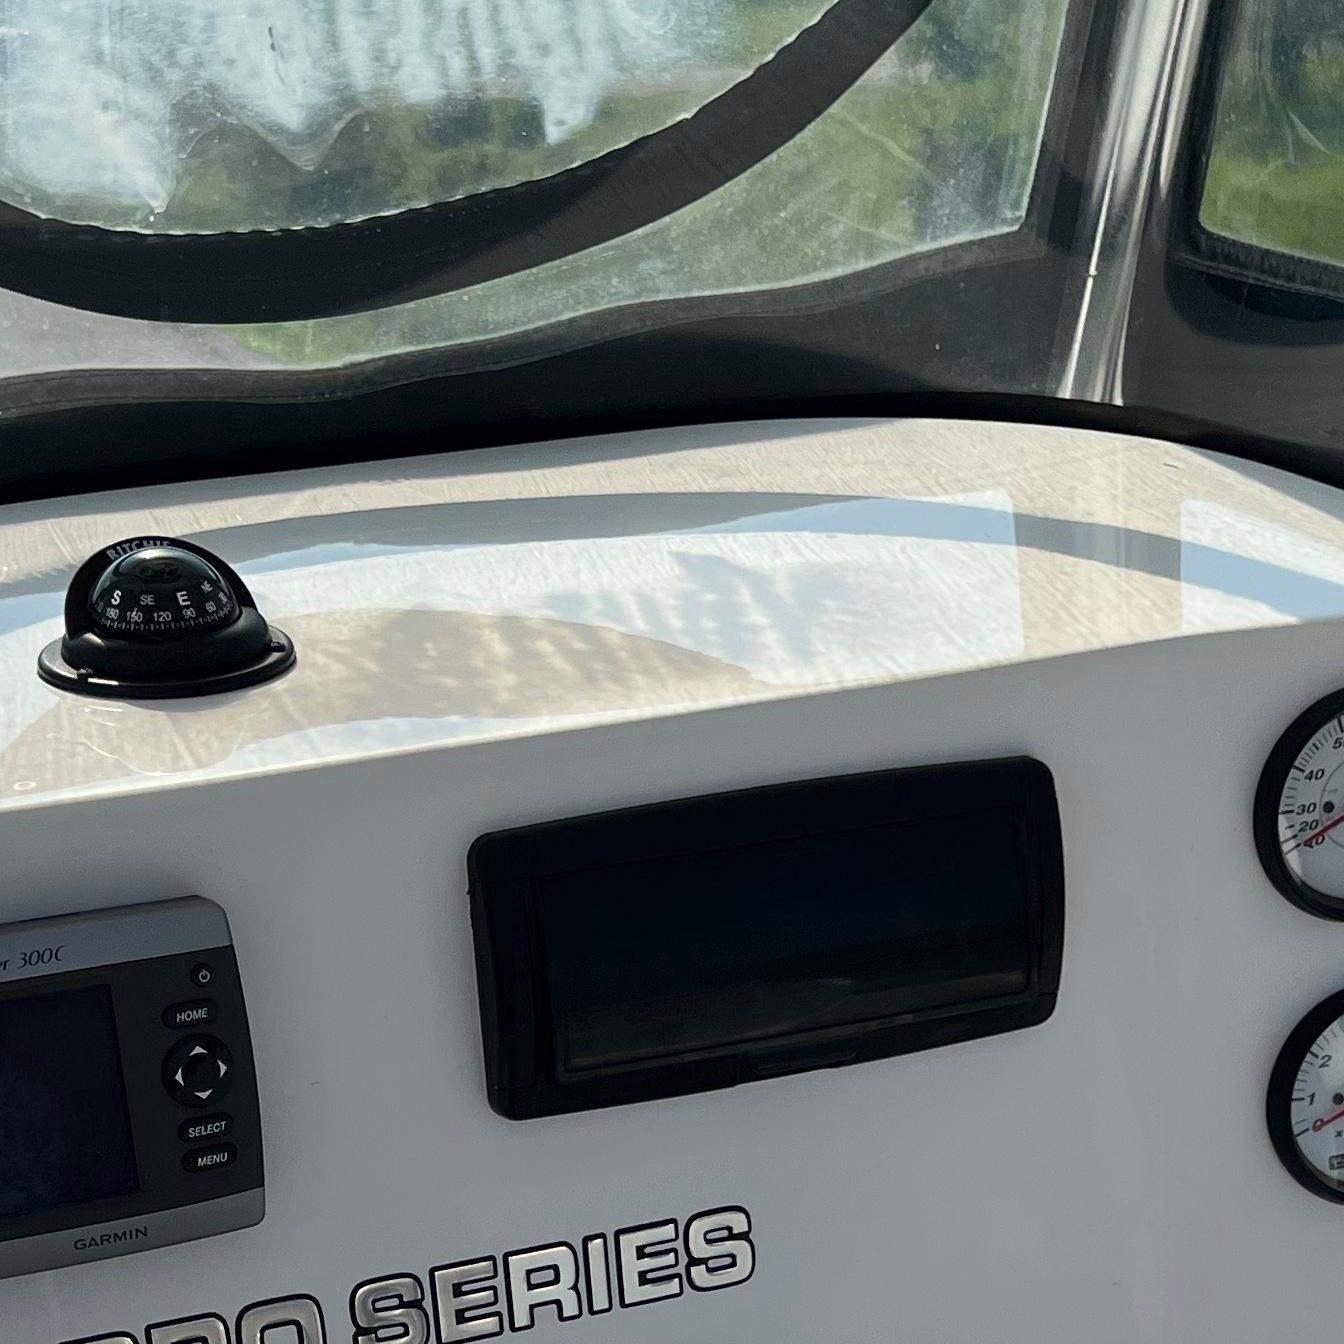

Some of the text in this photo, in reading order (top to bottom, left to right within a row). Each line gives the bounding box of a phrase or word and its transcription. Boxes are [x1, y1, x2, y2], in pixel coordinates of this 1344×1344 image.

[111, 590, 191, 606] S SE E
[153, 611, 172, 622] 120
[182, 607, 196, 618] 90
[1303, 768, 1325, 782] 40
[1295, 802, 1317, 816] 30
[1297, 819, 1319, 833] 20
[18, 945, 66, 970] 300C
[176, 1007, 209, 1024] HOME
[1318, 1054, 1332, 1069] 2
[188, 1120, 227, 1138] SELECT
[197, 1152, 228, 1168] MENU
[73, 1225, 149, 1252] GARMIN
